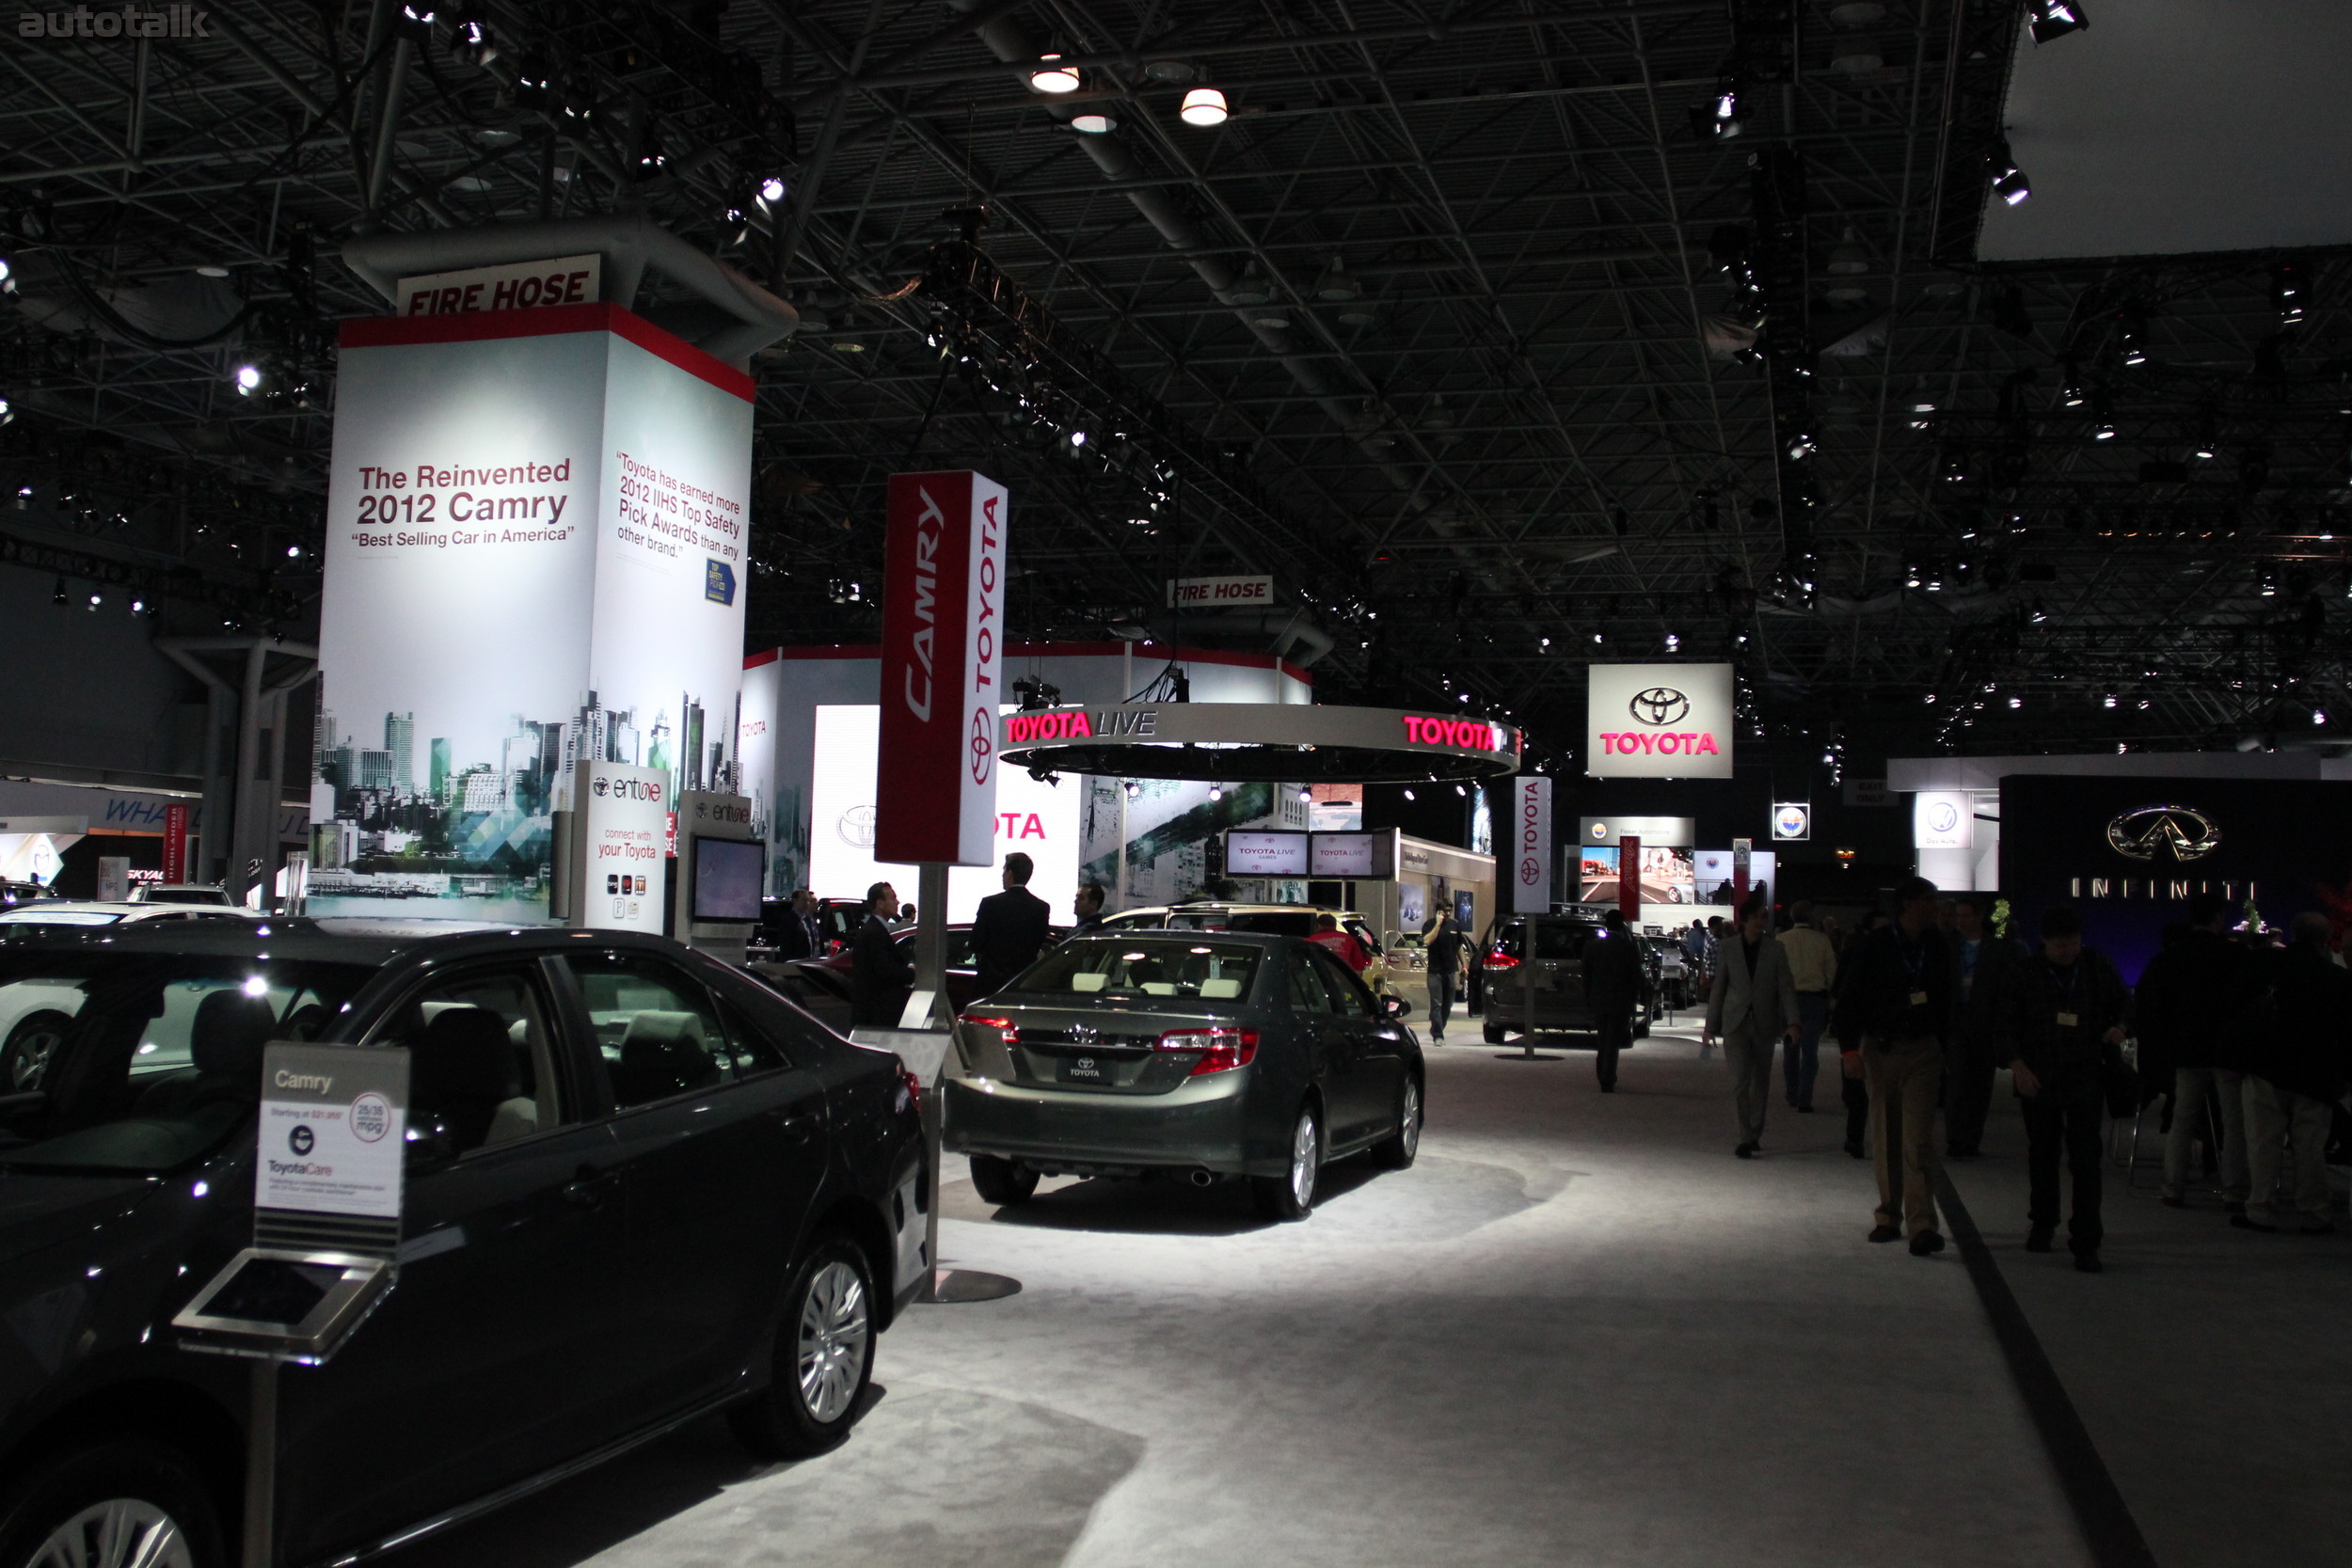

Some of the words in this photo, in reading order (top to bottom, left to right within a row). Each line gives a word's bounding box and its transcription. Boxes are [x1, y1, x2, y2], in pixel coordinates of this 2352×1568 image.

[408, 283, 485, 316] FIRE
[492, 270, 590, 310] HOSE
[358, 467, 407, 490] The
[417, 458, 570, 488] Reinvented
[660, 469, 677, 490] has
[680, 483, 714, 505] earned
[716, 497, 740, 515] more
[357, 493, 436, 525] 2012
[449, 491, 567, 525] Camry
[620, 475, 650, 503] 2012
[653, 488, 677, 514] IIHS
[681, 499, 701, 526] Top
[705, 509, 739, 540] Safety
[396, 531, 447, 548] Selling
[452, 531, 479, 545] Car
[483, 530, 497, 544] in
[617, 527, 644, 546] other
[619, 498, 648, 527] Pick
[651, 512, 698, 545] Awards
[701, 534, 720, 553] than
[723, 544, 739, 562] any
[905, 483, 946, 723] CAMRY
[977, 496, 999, 693] TOYOTA
[1172, 584, 1211, 601] FIRE
[1215, 582, 1267, 599] HOSE
[742, 720, 767, 737] TOYOTA
[1006, 712, 1093, 743] TOYOTA
[1094, 709, 1159, 737] LIVE
[1403, 716, 1497, 752] TOYOTA
[1599, 732, 1720, 755] TOYOTA
[1524, 782, 1539, 854] TOYOTA
[168, 807, 177, 879] HIGHLANDER
[605, 829, 635, 841] connect
[637, 832, 651, 841] with
[598, 844, 621, 859] your
[624, 843, 656, 861] Toyota
[2071, 878, 2255, 901] INFINITI
[275, 1069, 332, 1095] Camry
[1070, 1069, 1100, 1077] TOYOTA
[270, 1107, 300, 1119] Starting
[268, 1160, 333, 1176] ToyotaCare
